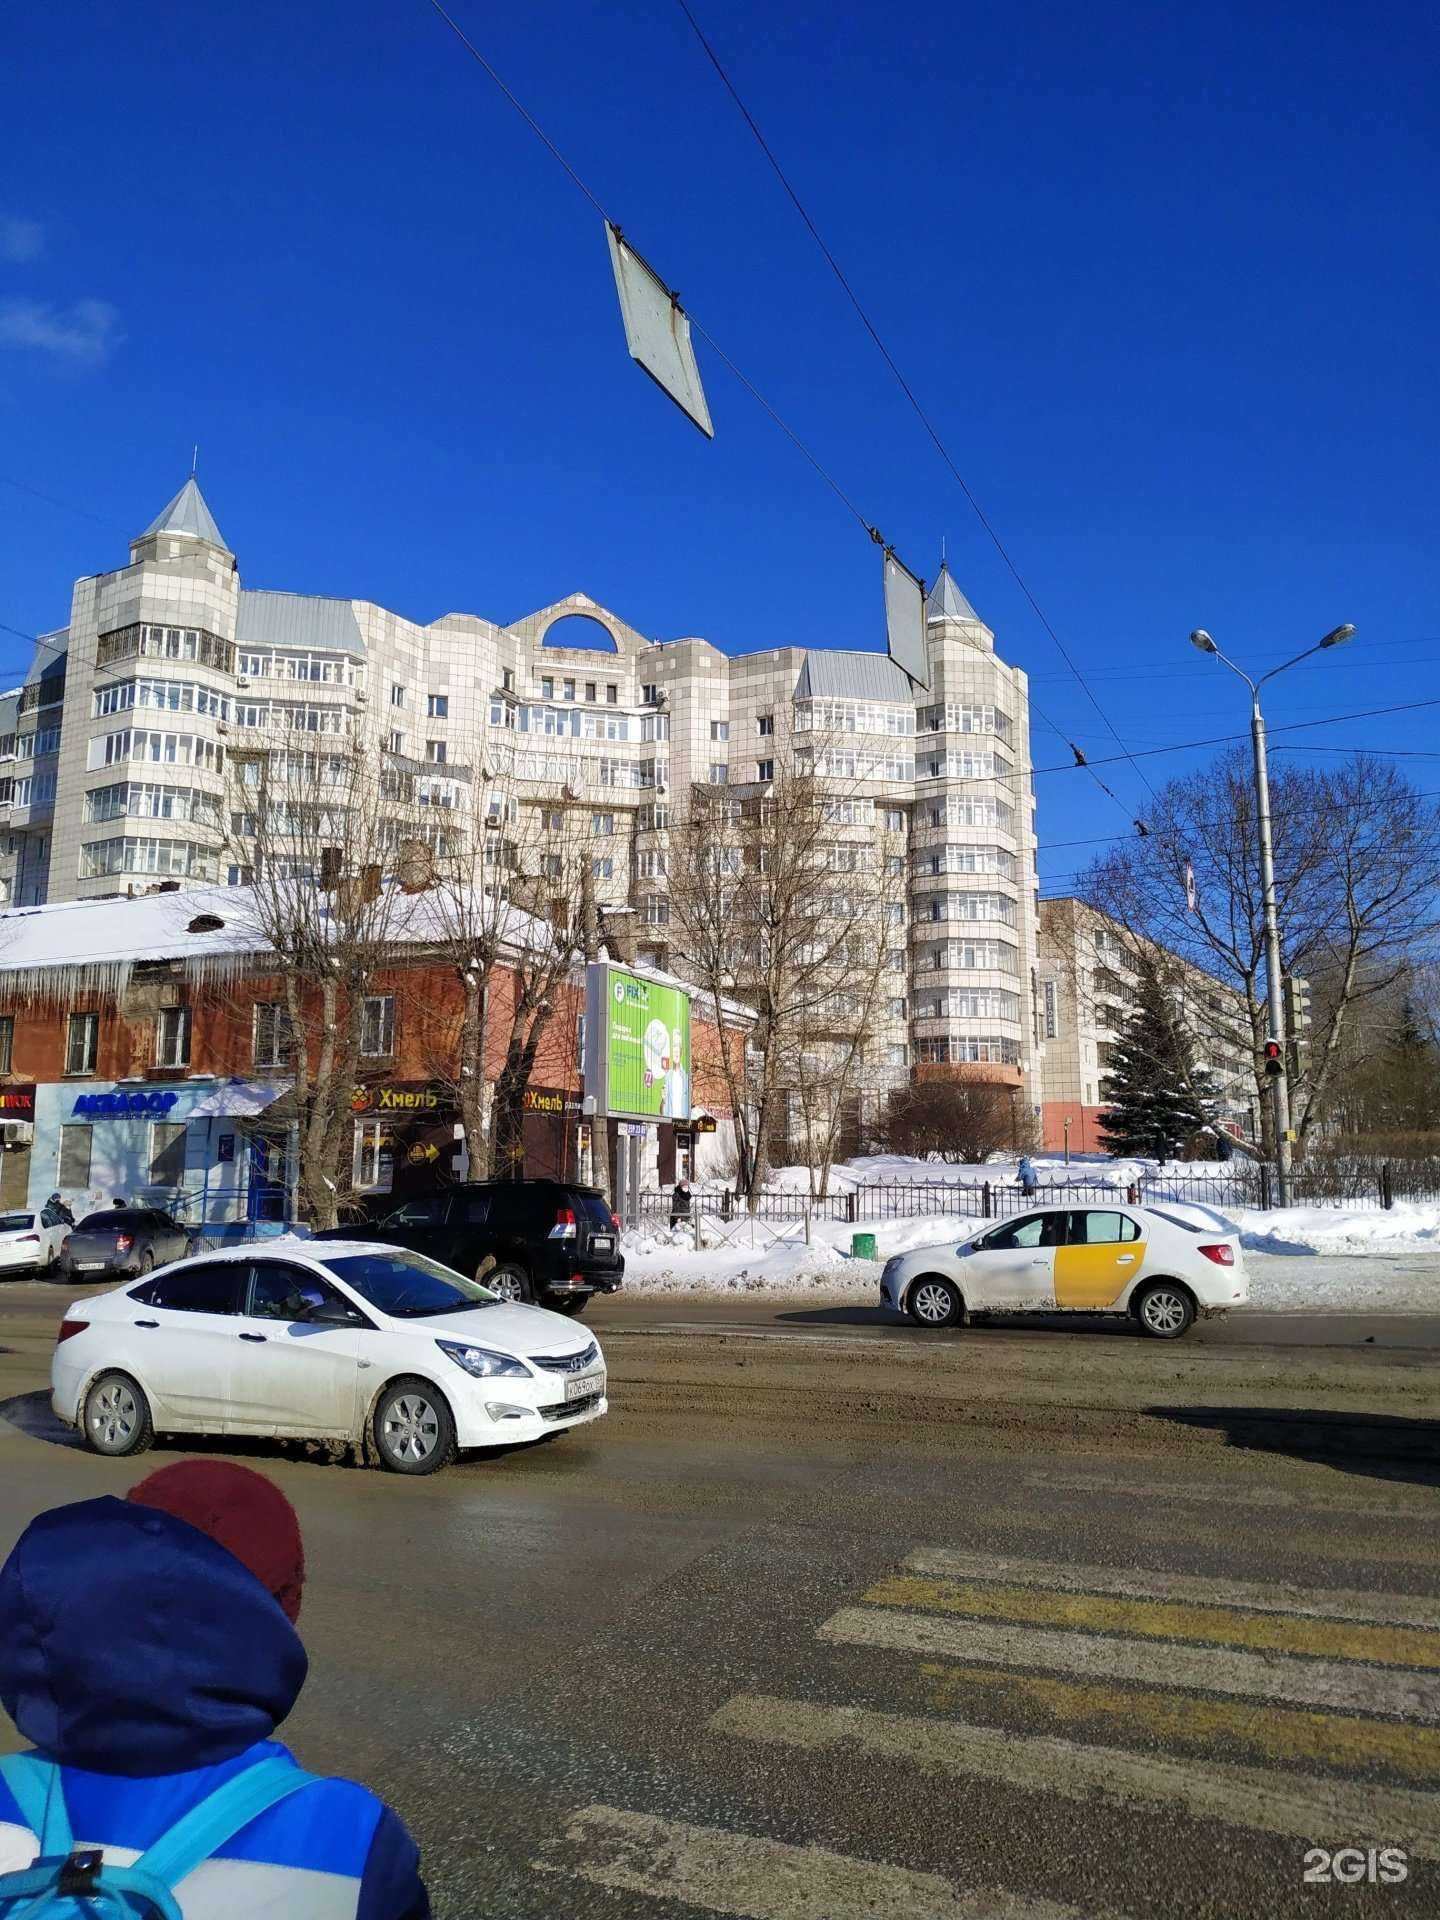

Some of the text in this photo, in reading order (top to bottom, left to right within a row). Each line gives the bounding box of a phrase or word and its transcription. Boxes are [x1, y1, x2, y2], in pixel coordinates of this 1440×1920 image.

[71, 1092, 178, 1117] АКВАФОР
[379, 1089, 437, 1107] Хмель
[530, 1091, 563, 1110] Хмель
